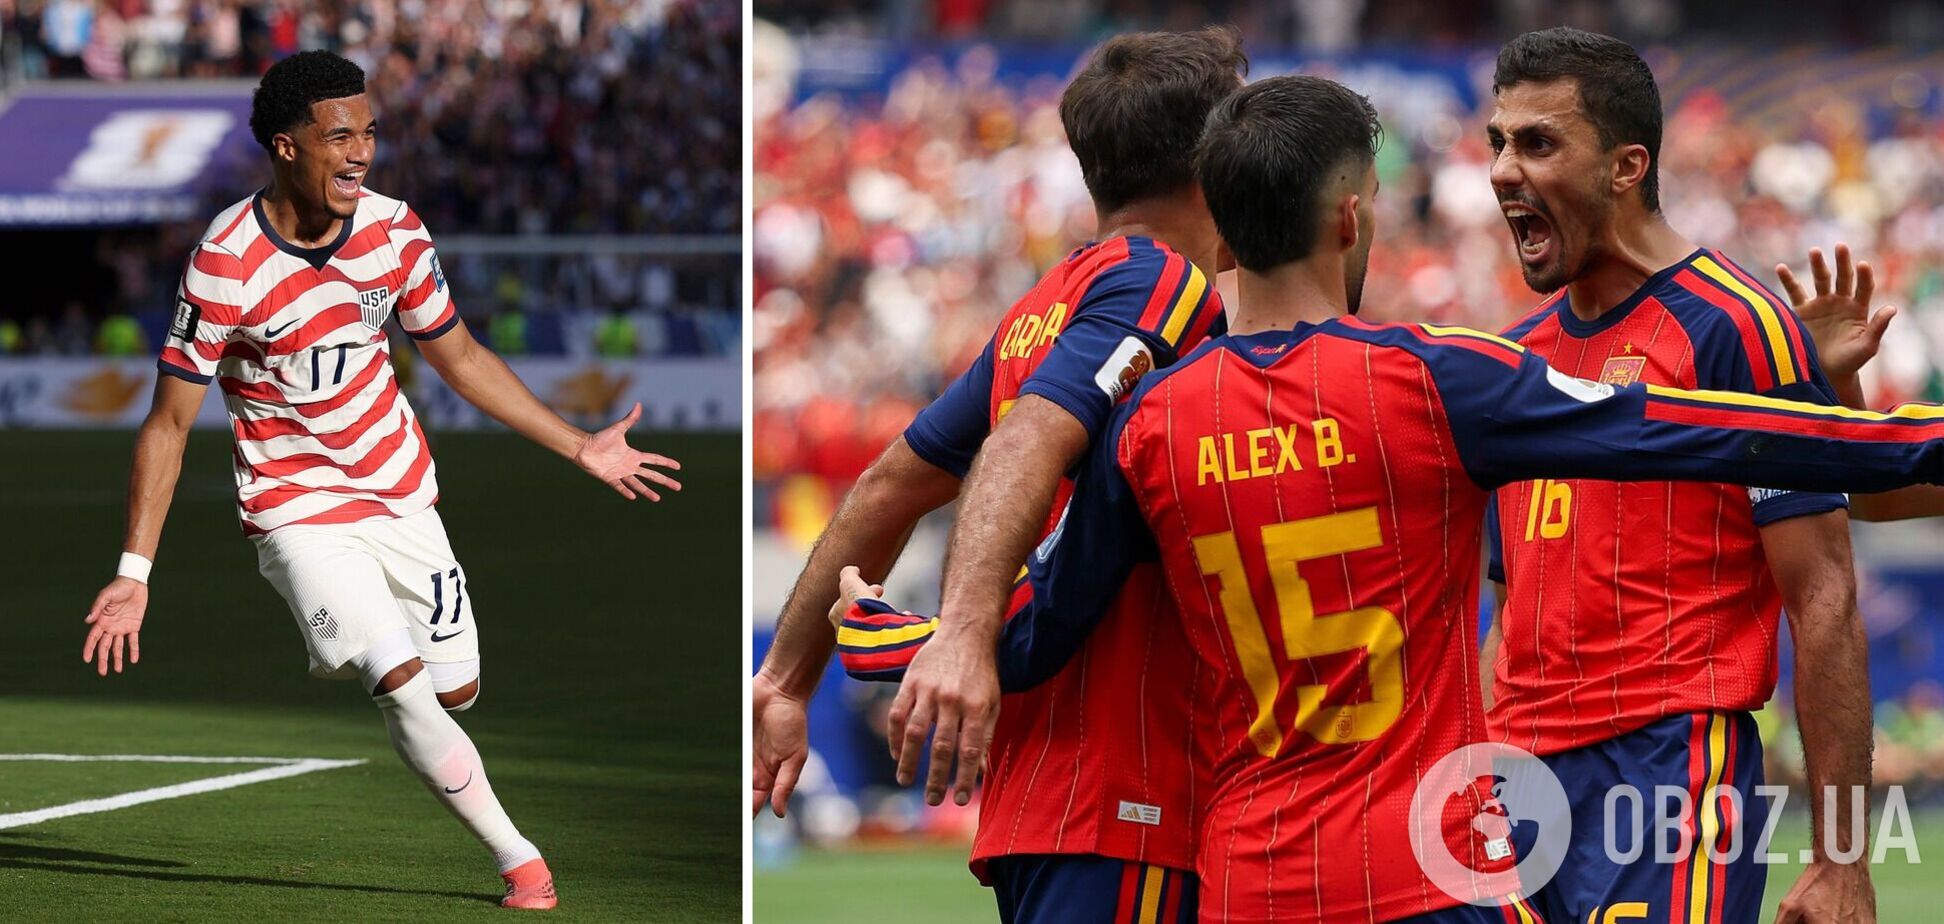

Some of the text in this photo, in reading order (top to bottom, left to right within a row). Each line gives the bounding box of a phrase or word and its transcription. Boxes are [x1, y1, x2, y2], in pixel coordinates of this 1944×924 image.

[361, 288, 388, 308] USA
[1197, 417, 1357, 486] ALEX B.
[1525, 479, 1572, 543] 16
[309, 607, 328, 627] USA
[1192, 505, 1405, 760] 15
